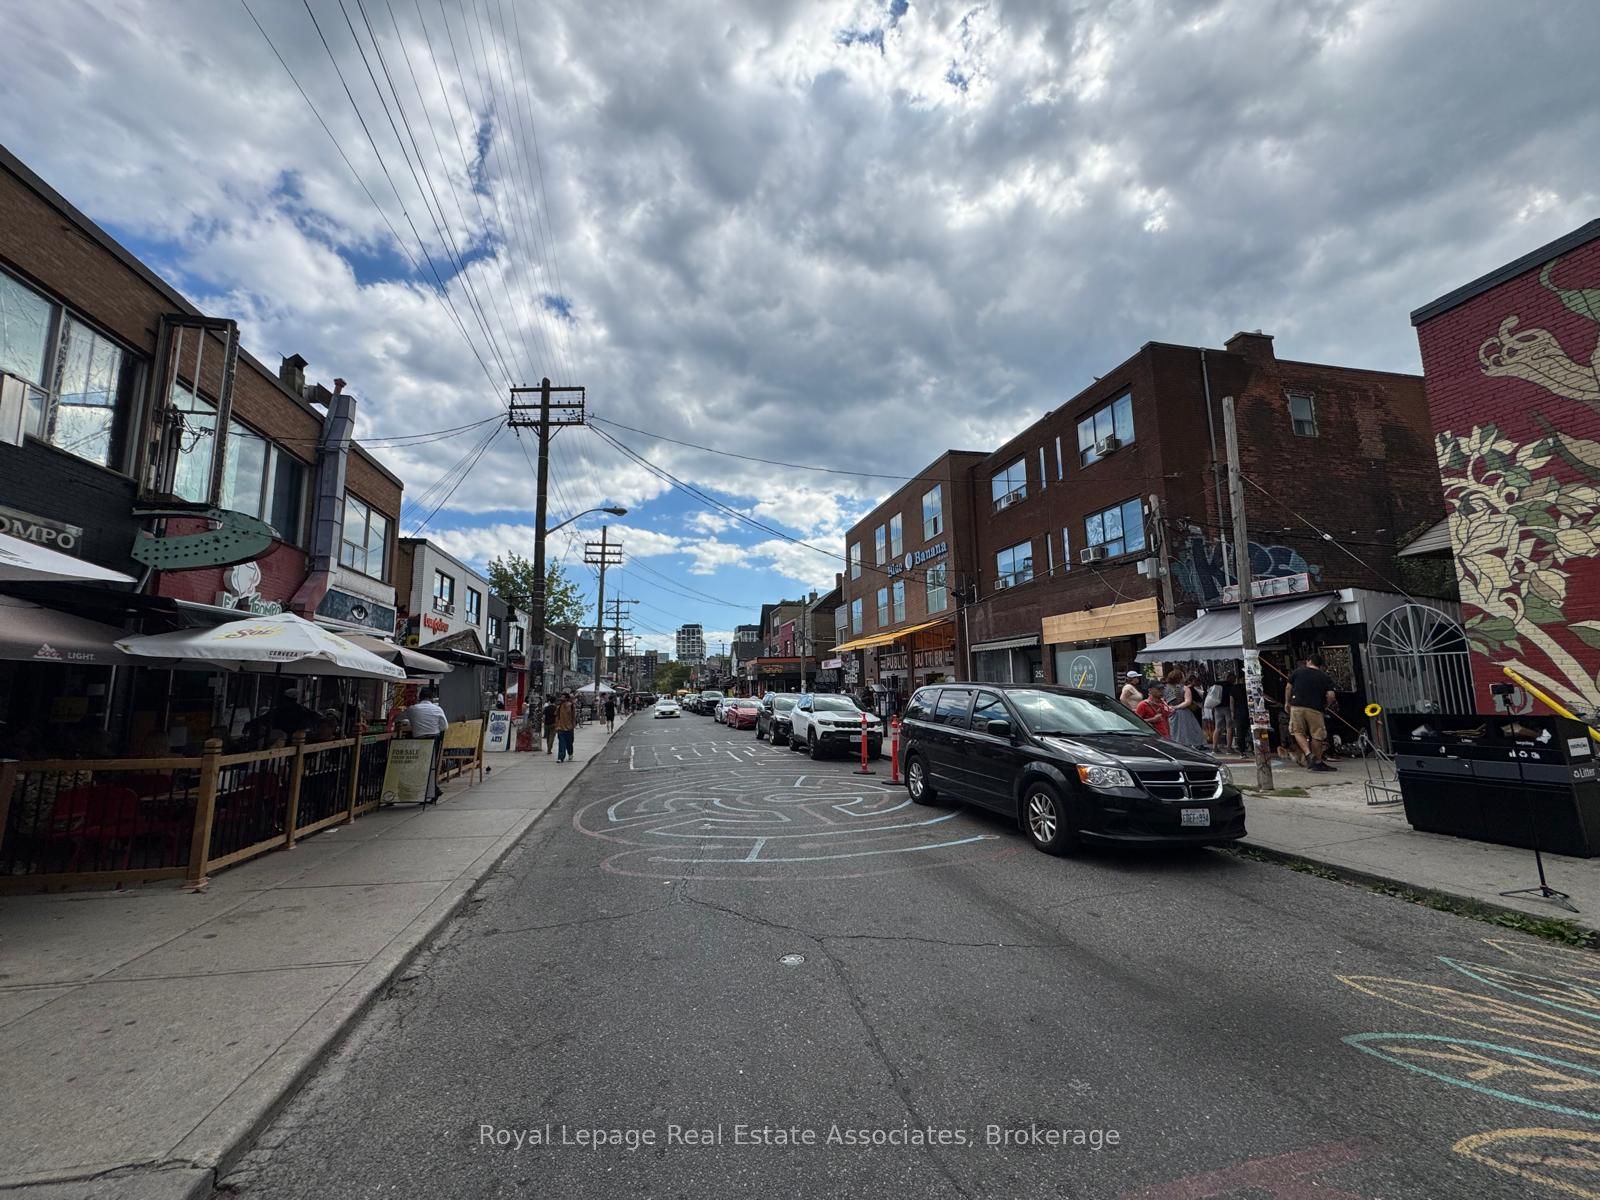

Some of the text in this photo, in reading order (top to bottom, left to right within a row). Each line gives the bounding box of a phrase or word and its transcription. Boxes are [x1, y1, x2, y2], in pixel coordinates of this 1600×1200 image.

[914, 542, 947, 565] Banana
[1225, 578, 1298, 602] SVER
[67, 652, 94, 660] LIGHT
[887, 655, 908, 669] PUBLIC
[1580, 768, 1595, 777] Litter
